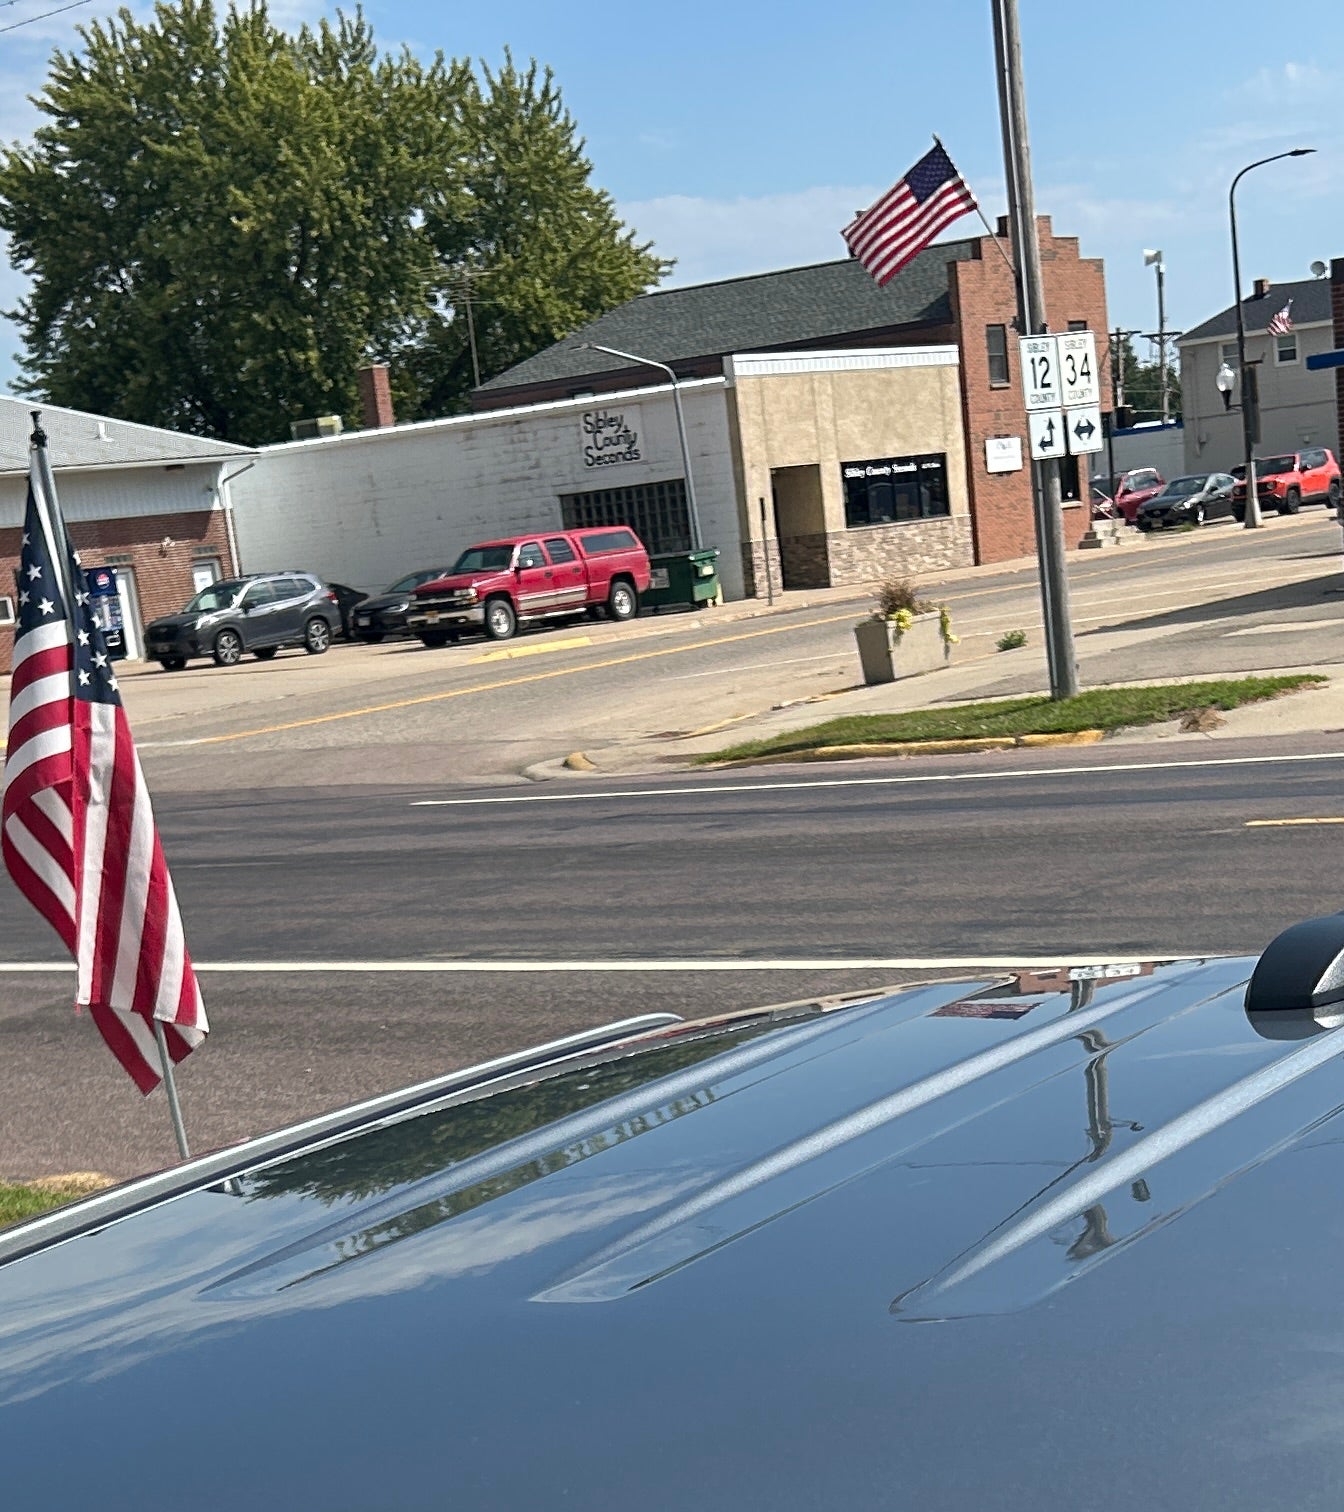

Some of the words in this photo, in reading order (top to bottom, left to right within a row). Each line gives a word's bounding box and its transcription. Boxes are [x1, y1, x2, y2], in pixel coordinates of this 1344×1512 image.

[1030, 356, 1052, 389] 12
[1066, 352, 1091, 386] 34
[593, 425, 638, 451] County
[584, 446, 641, 467] Seconds
